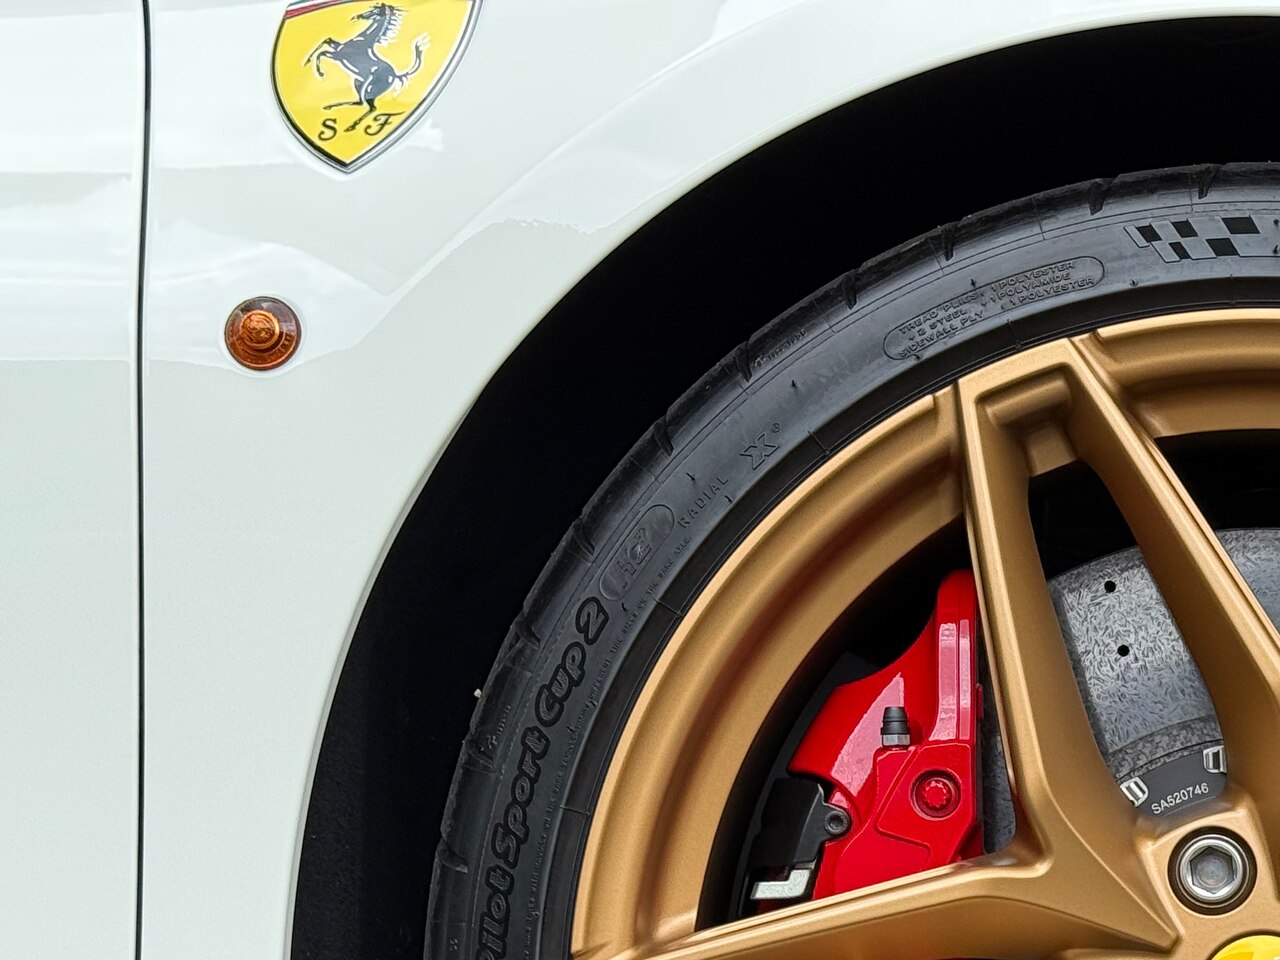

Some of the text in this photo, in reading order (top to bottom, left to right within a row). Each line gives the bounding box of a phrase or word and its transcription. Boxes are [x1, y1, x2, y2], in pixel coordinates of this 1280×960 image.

[318, 111, 406, 141] S F
[897, 309, 938, 335] TREAD
[928, 307, 966, 330] STEEL
[897, 322, 957, 357] SIDEWALL
[677, 473, 728, 529] RADIAL
[489, 723, 551, 867] Sport
[533, 641, 585, 726] Cup
[574, 595, 610, 646] 2
[1151, 782, 1209, 815] SA520746
